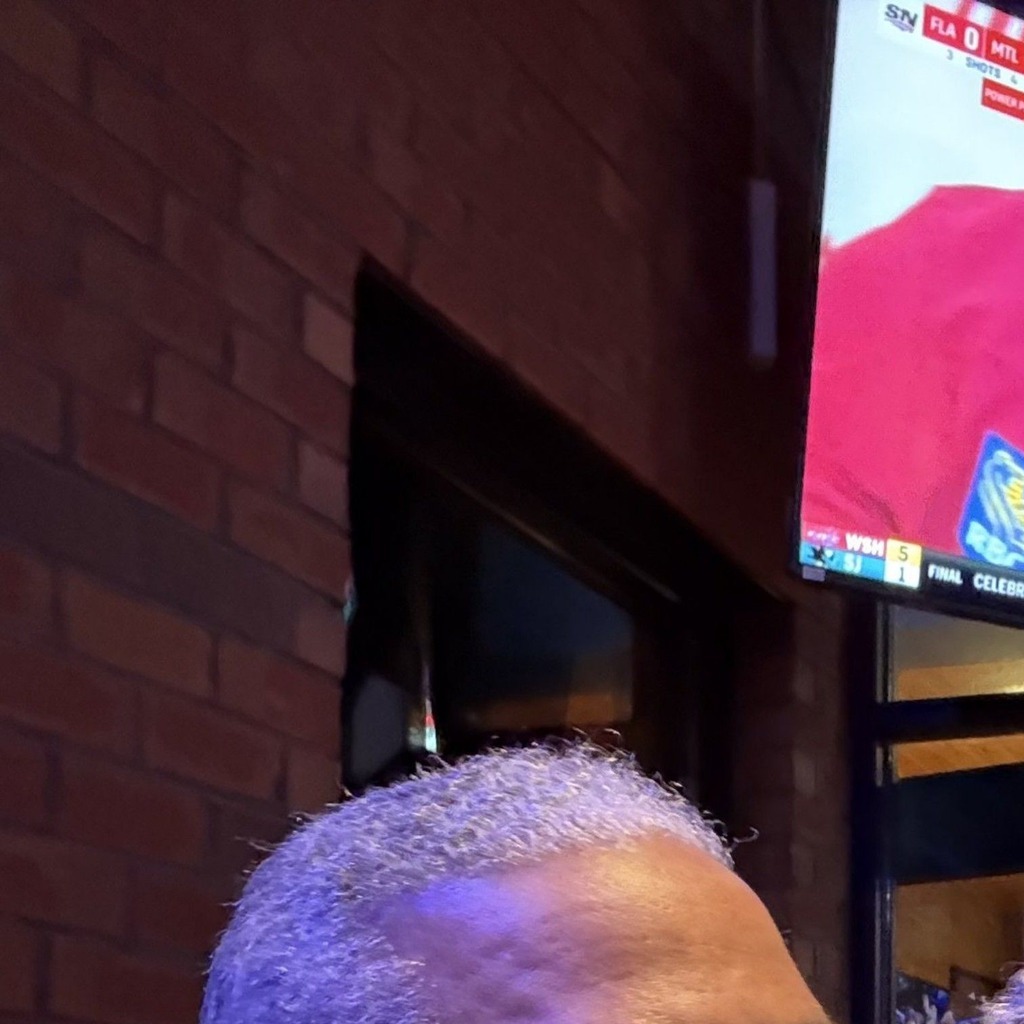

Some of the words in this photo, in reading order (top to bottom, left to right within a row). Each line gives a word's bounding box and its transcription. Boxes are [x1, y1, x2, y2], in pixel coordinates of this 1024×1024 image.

[930, 16, 956, 39] FLA
[964, 27, 980, 50] 0
[991, 40, 1019, 64] MTL
[965, 57, 1001, 78] SHOTS
[984, 87, 1017, 109] POWER
[845, 532, 885, 557] WSH
[898, 546, 908, 562] 5
[843, 552, 862, 574] SJ
[899, 567, 905, 582] 1
[928, 564, 963, 585] FINAL
